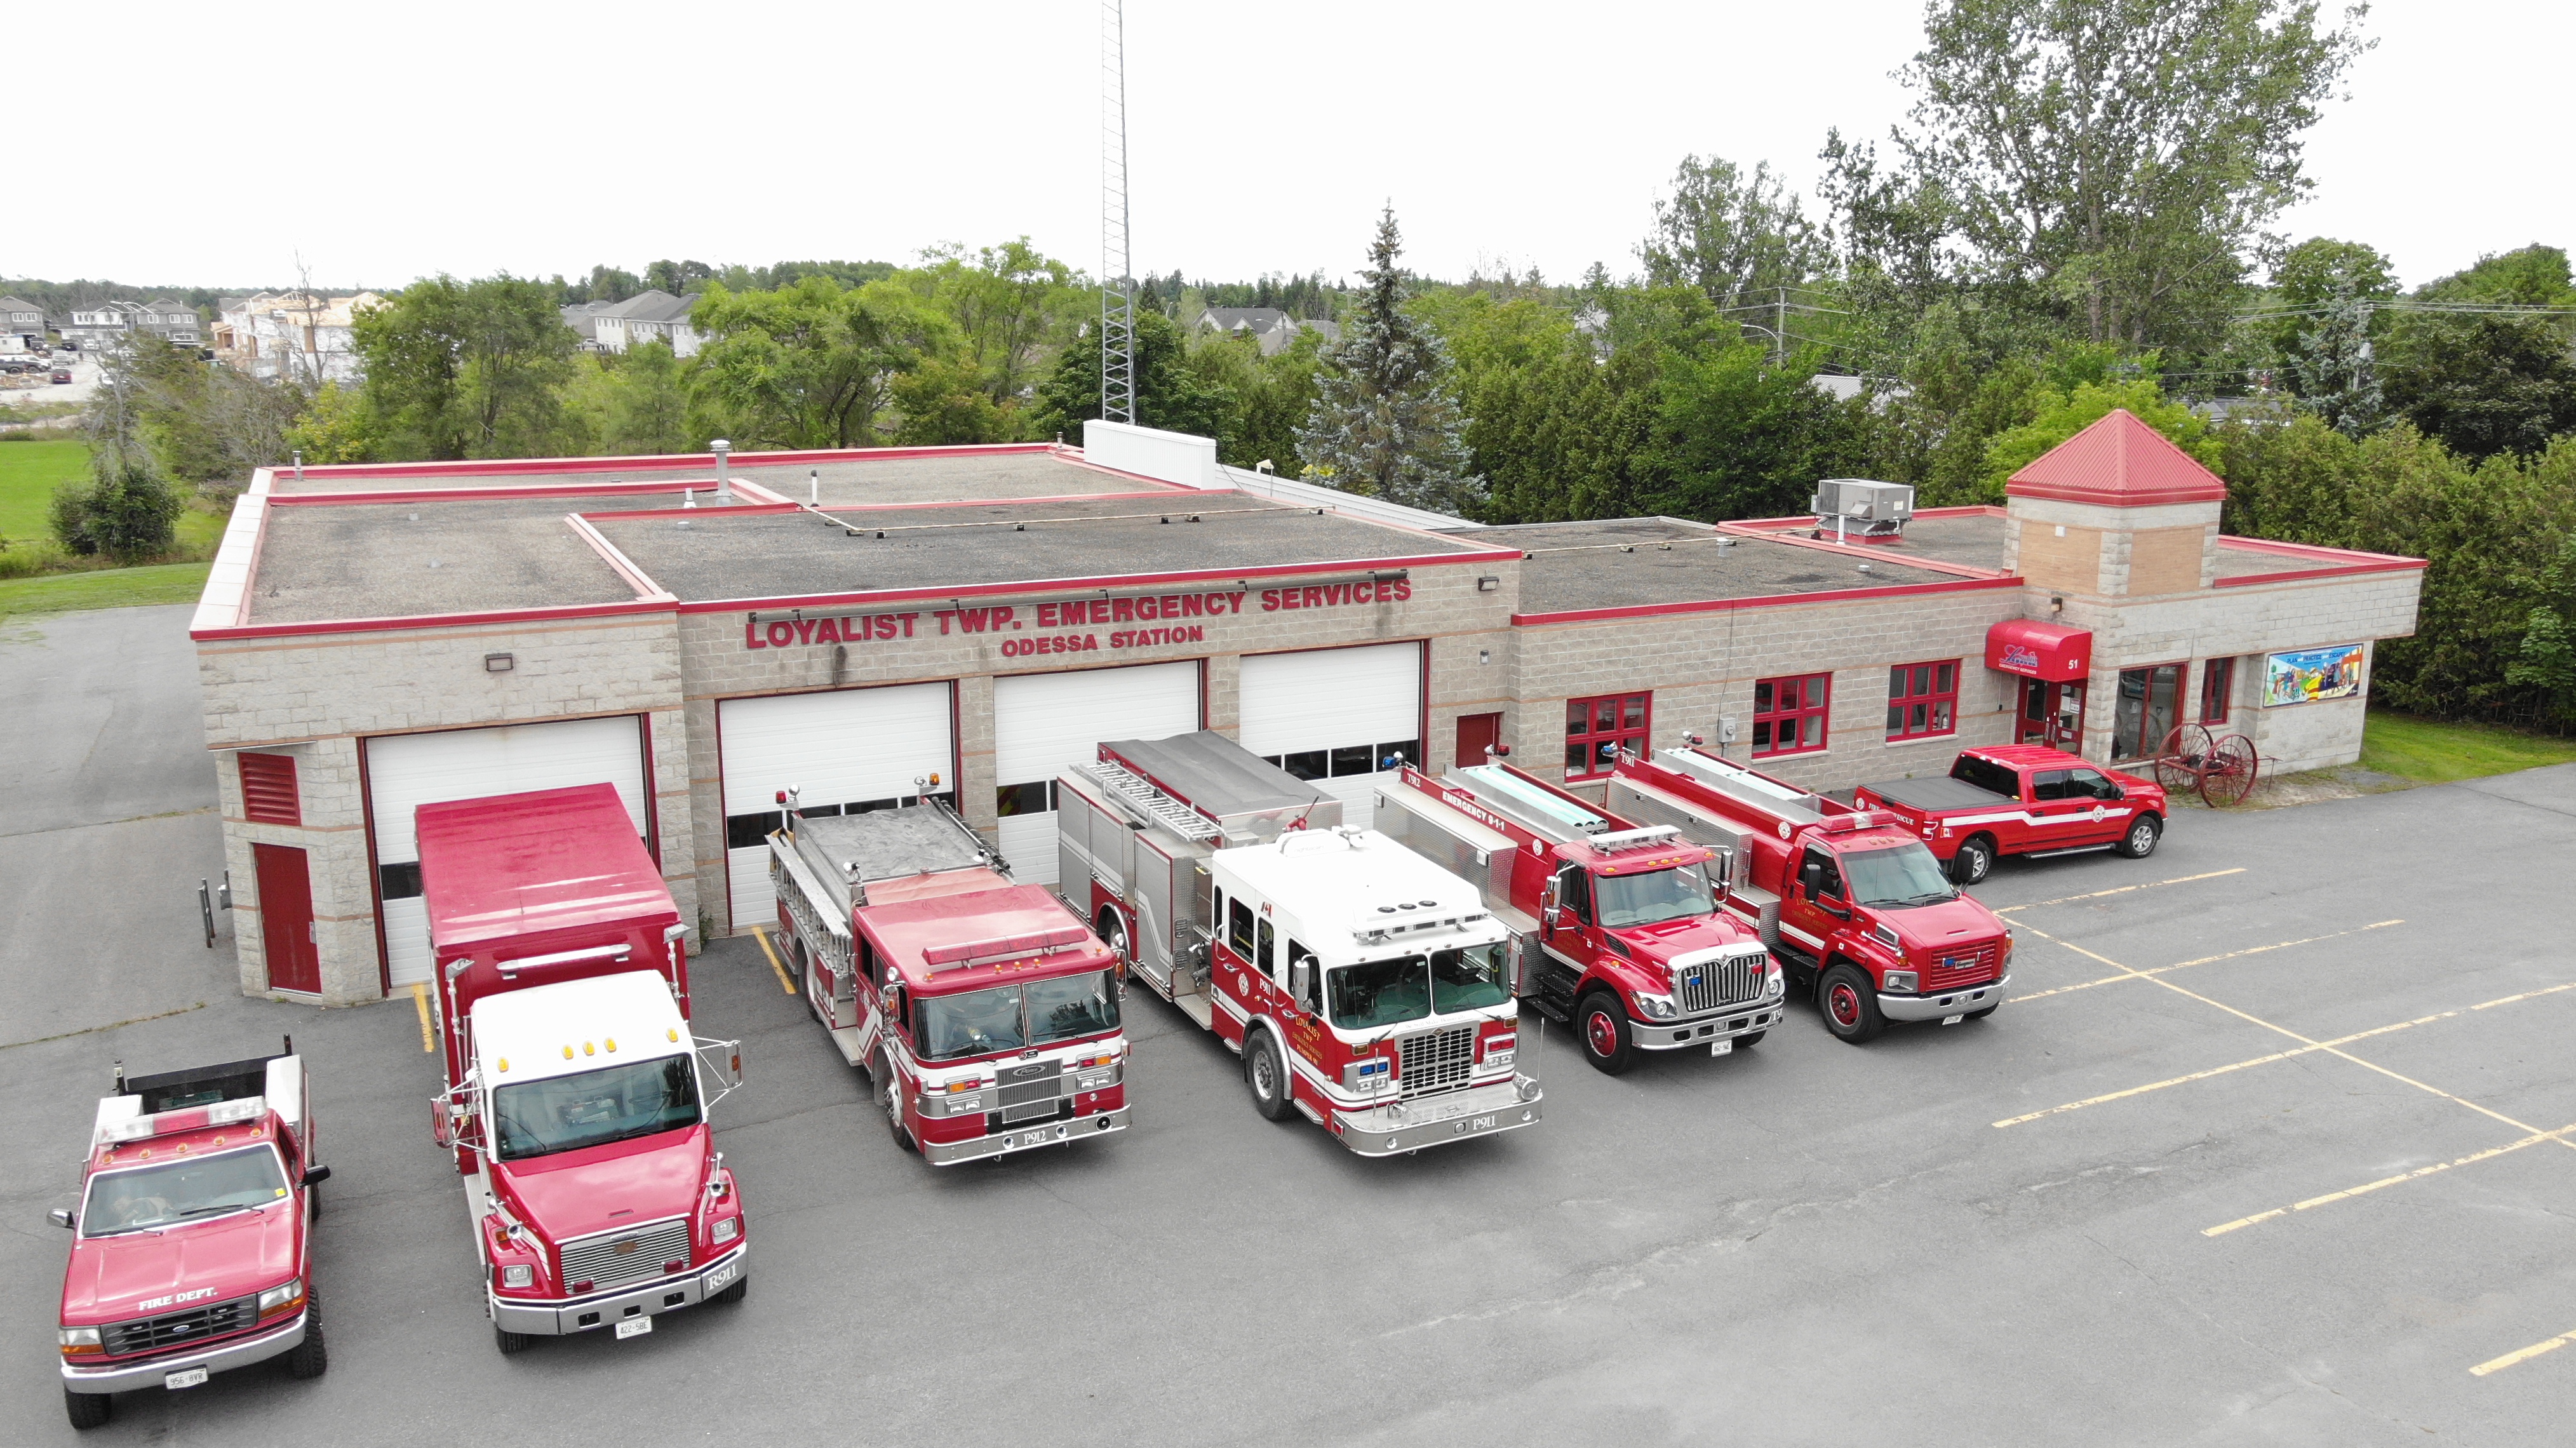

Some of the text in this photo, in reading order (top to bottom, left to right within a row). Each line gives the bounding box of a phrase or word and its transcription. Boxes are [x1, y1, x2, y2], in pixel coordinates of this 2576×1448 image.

[746, 579, 1412, 648] LOYALIST TWP. EMERGENCY SERVICES
[1002, 625, 1203, 657] ODESSA STATION
[2068, 659, 2079, 669] 51
[1620, 754, 1635, 767] T911
[1407, 773, 1421, 788] T912
[1442, 791, 1487, 821] EMERGENCY
[1259, 977, 1271, 996] P911
[1296, 1017, 1320, 1041] LOYALIST
[1473, 1115, 1496, 1130] P911
[1023, 1130, 1046, 1144] P912
[708, 1263, 737, 1290] R911
[138, 1287, 218, 1311] FIRE DEPT.
